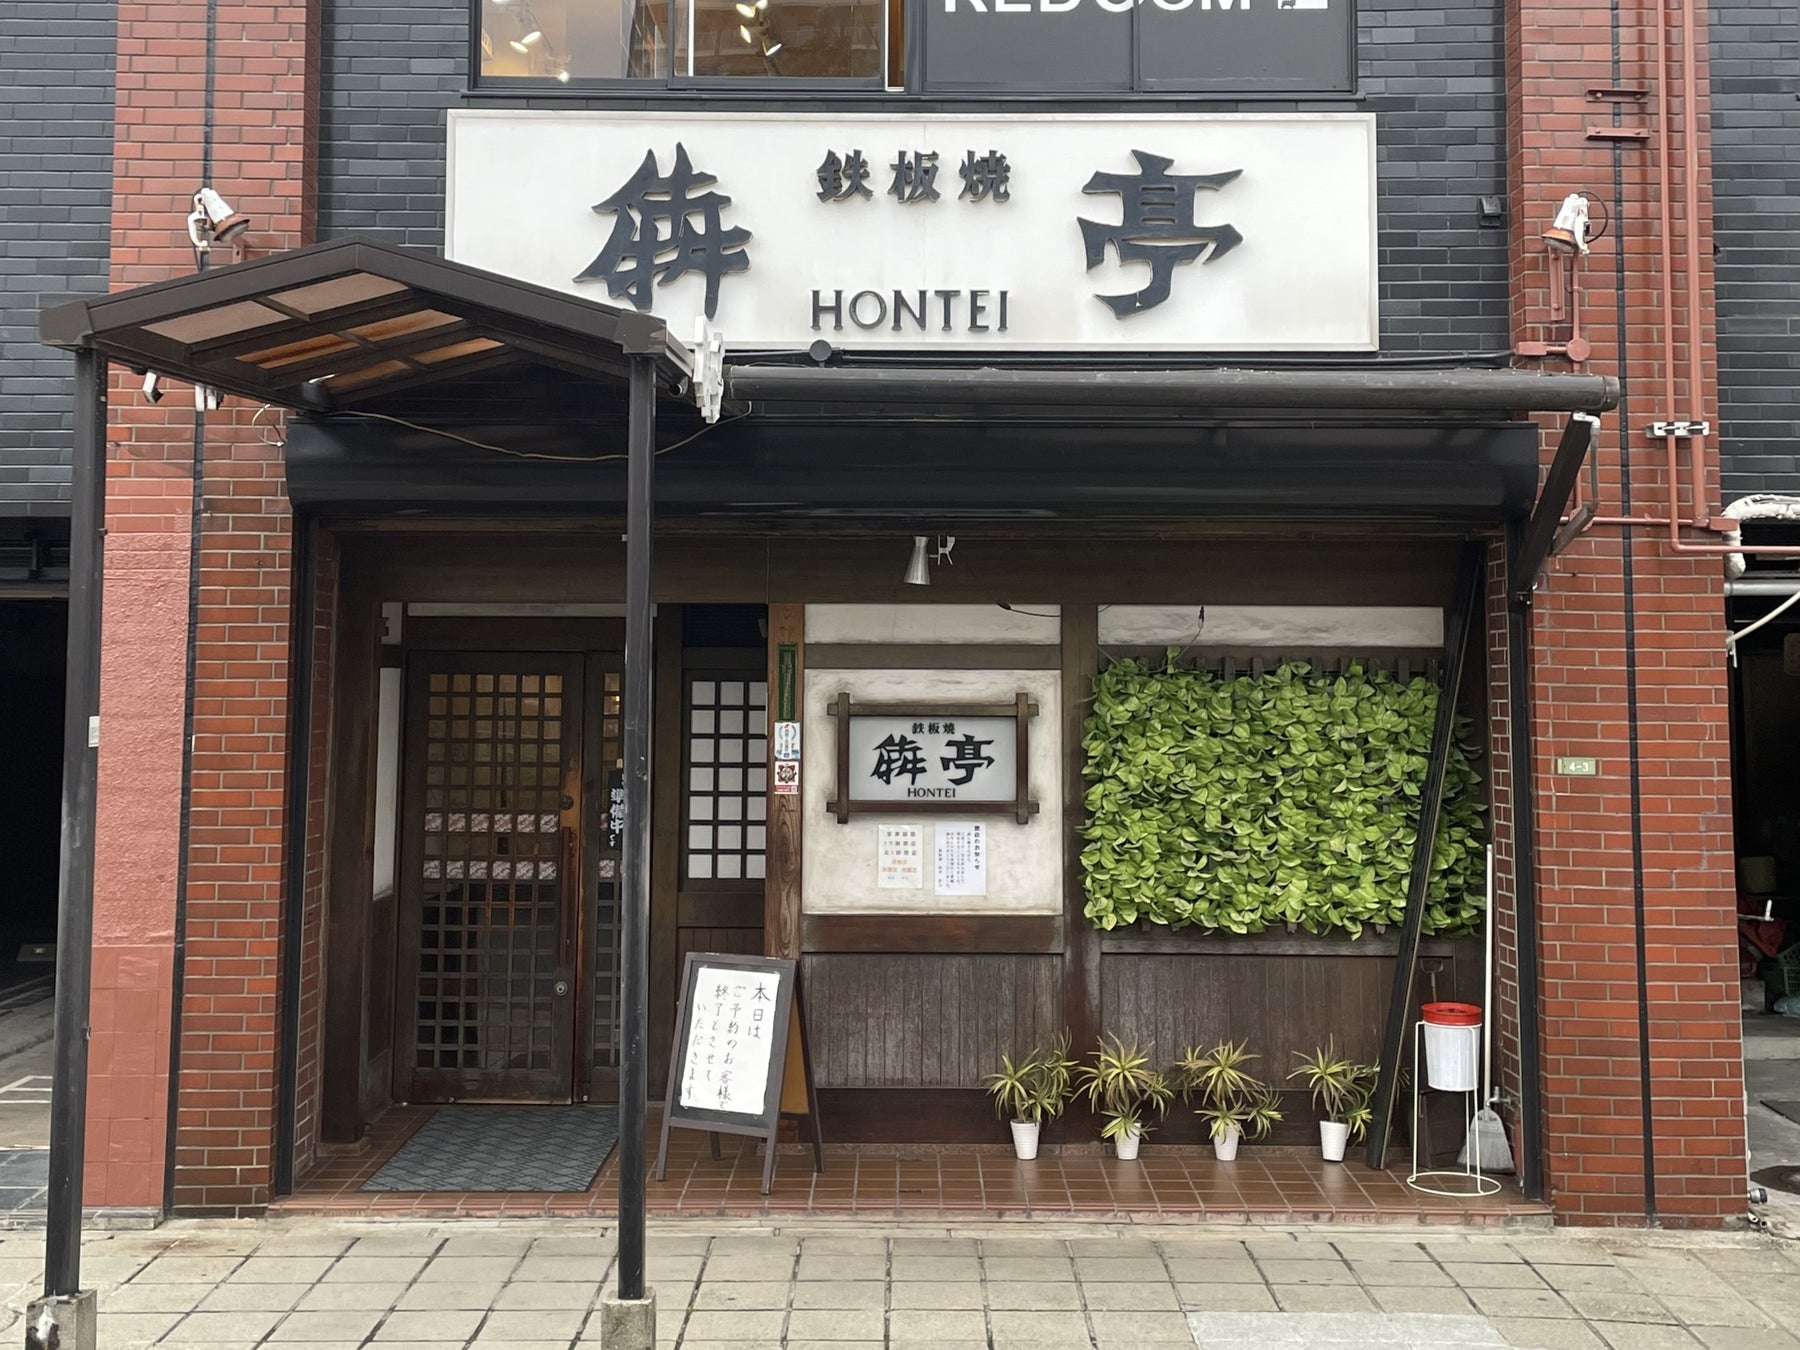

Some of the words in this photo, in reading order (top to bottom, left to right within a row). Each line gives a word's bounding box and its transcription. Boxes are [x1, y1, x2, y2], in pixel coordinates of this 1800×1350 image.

[815, 148, 1011, 204] 鉄板焼
[810, 289, 1010, 332] HONTEI
[911, 721, 956, 736] 鉄板焼
[1568, 761, 1590, 773] 4-3
[907, 787, 957, 799] HONTEI
[746, 981, 772, 1040] 本日は
